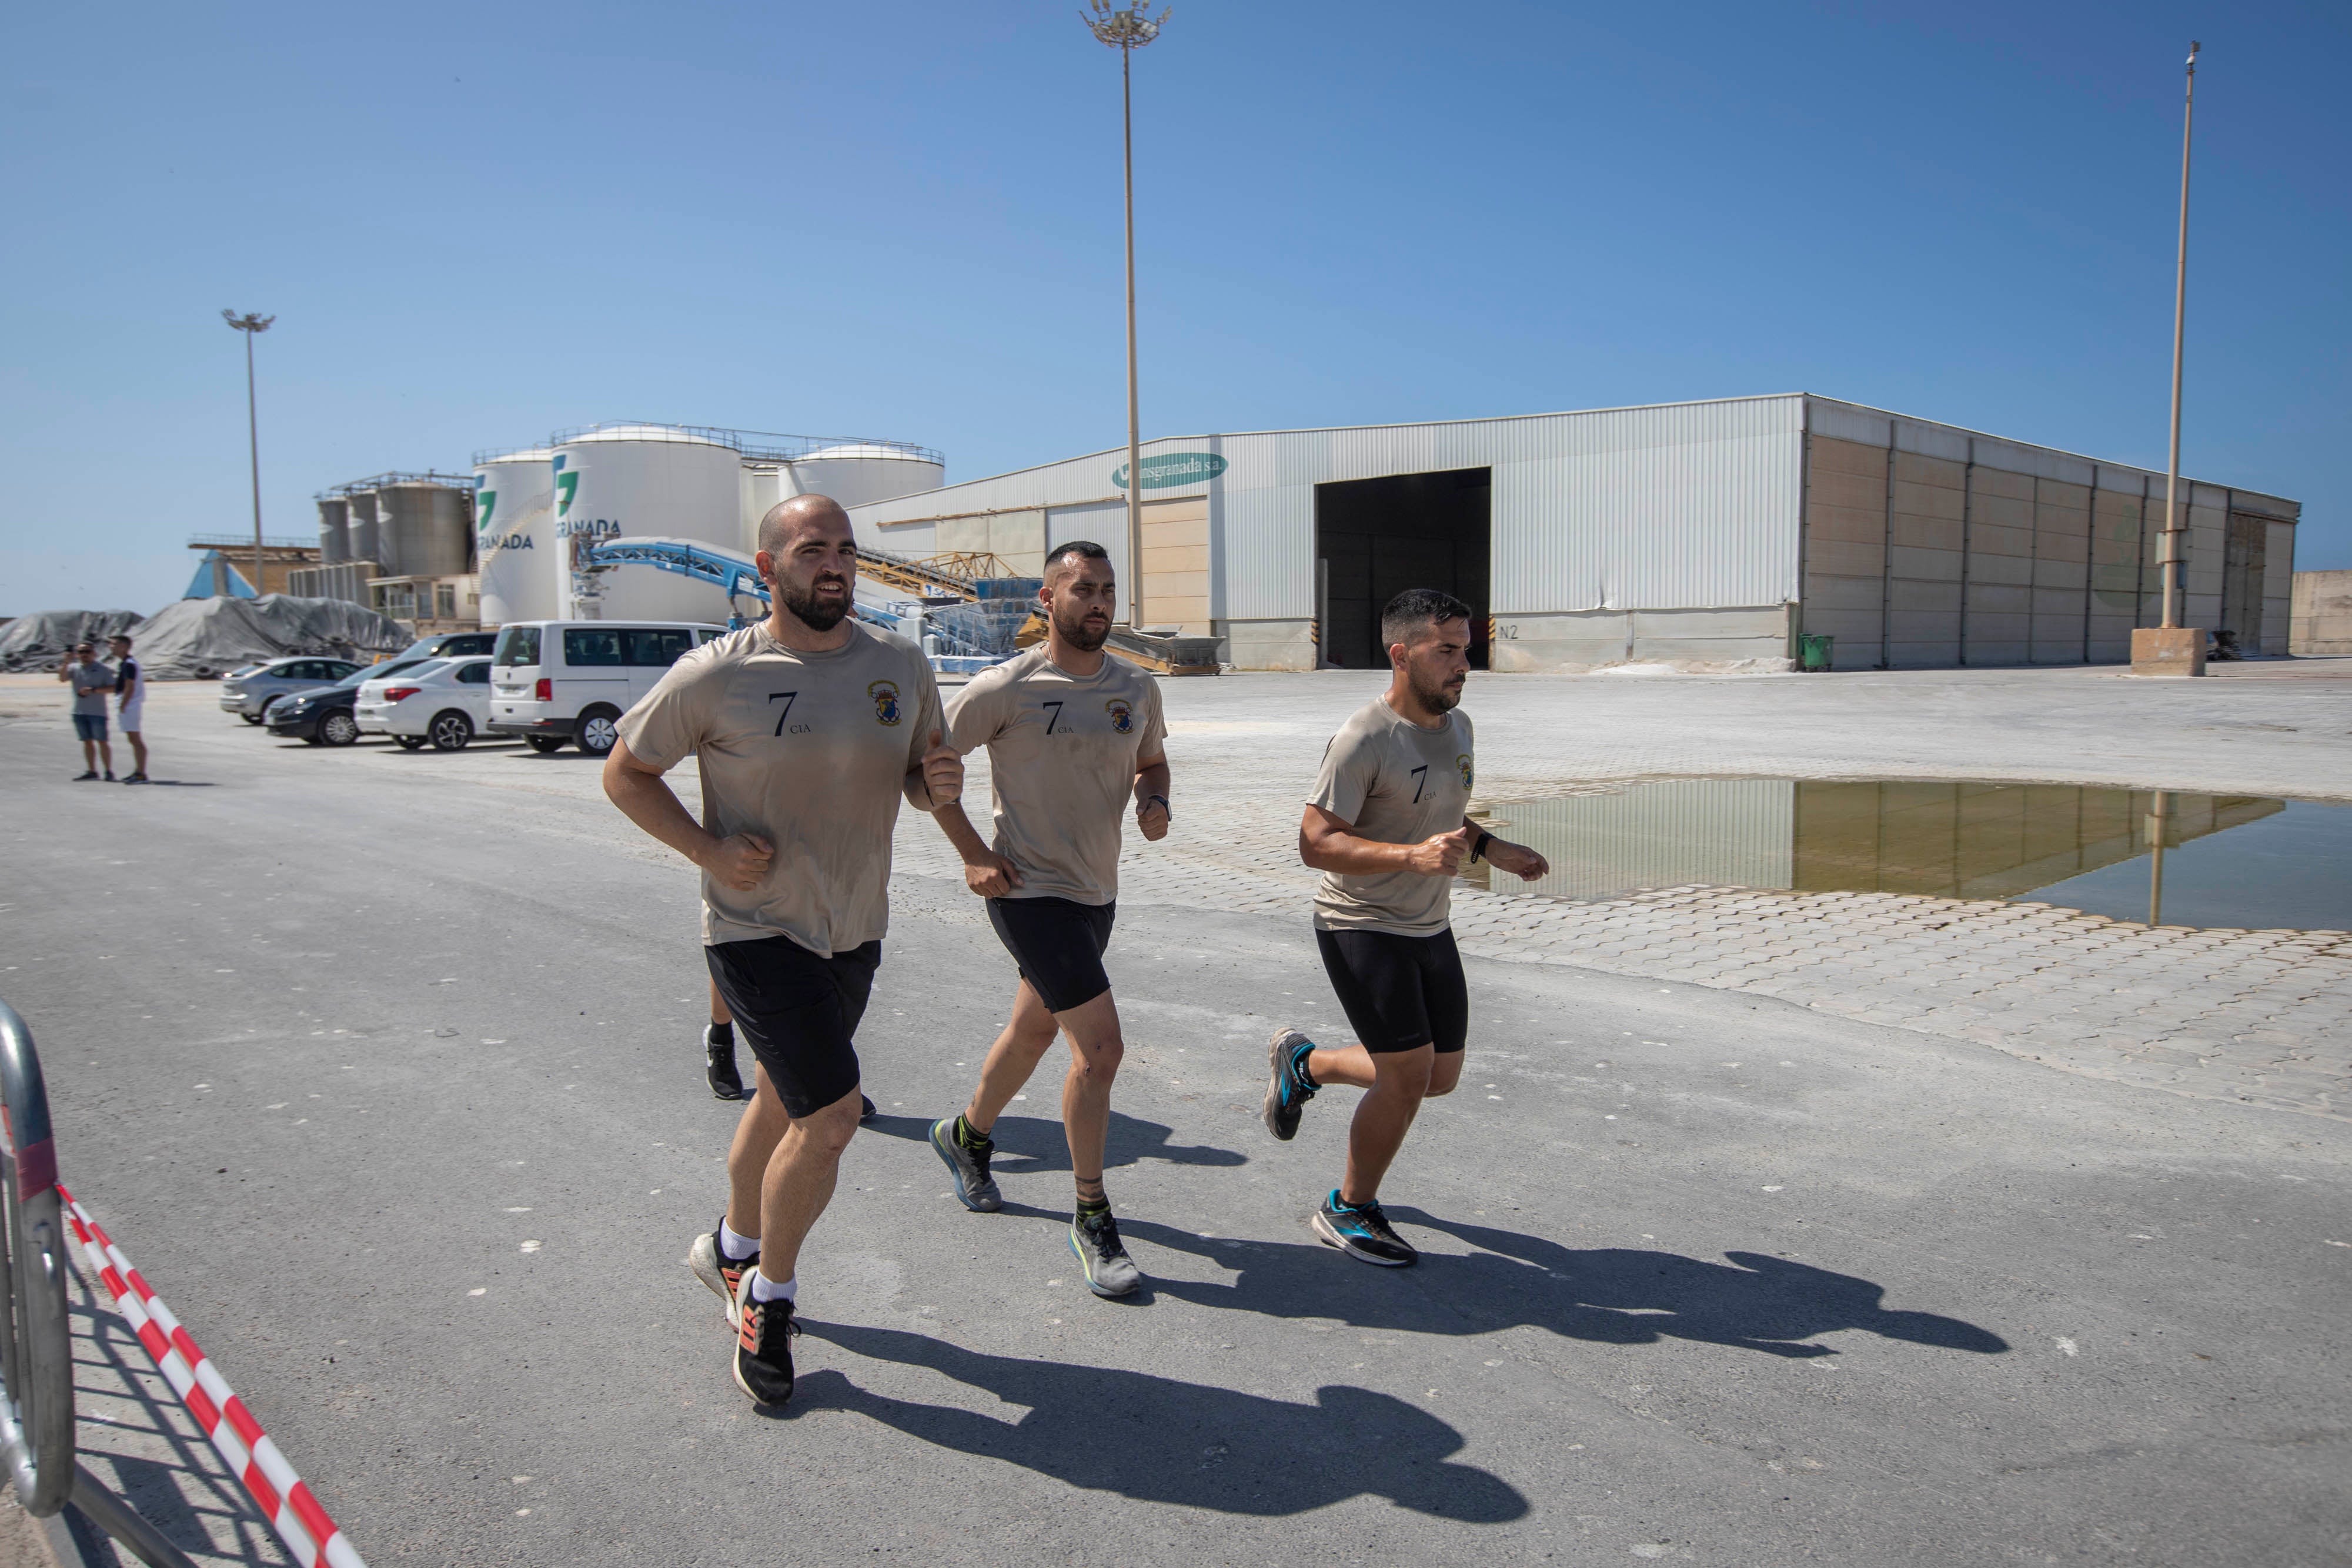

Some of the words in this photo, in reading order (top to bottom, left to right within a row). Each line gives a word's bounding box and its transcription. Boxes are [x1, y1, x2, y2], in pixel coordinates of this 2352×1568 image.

[1500, 624, 1519, 640] N2
[768, 691, 799, 737] 7
[790, 723, 811, 734] CIA
[1043, 701, 1064, 735] 7
[1058, 726, 1075, 734] CIA
[1411, 764, 1429, 804] 7
[1424, 790, 1438, 801] CIA
